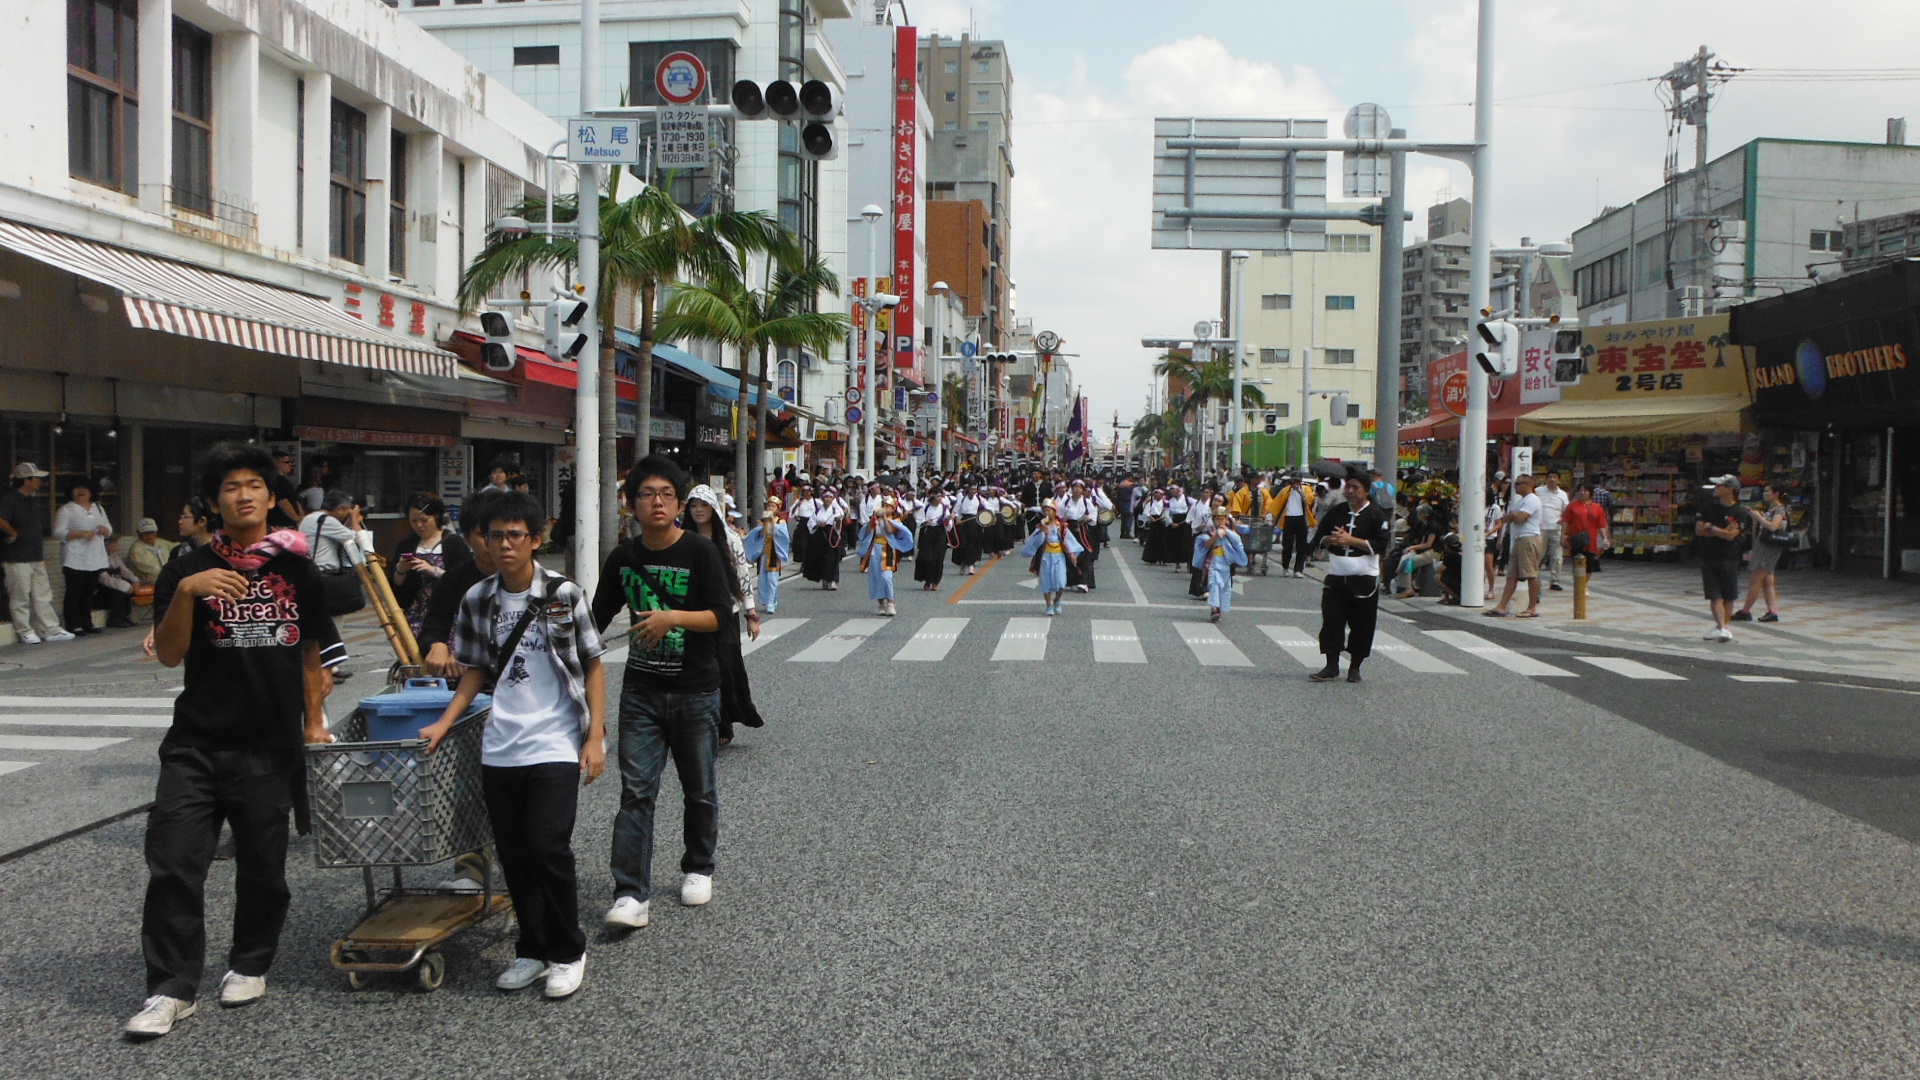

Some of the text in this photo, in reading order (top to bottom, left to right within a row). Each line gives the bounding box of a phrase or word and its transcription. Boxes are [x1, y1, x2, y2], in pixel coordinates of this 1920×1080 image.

[578, 126, 629, 144] 松尾
[584, 146, 621, 157] Matsuo
[897, 120, 914, 232] おきなわ屋
[899, 260, 911, 313] 本社ビル
[1606, 323, 1696, 342] おみやげ屋
[896, 336, 911, 352] P
[1596, 340, 1708, 374] 東宝堂
[1752, 343, 1907, 389] ISLAND BROTHERS
[1615, 372, 1684, 392] 2号店
[220, 599, 300, 622] Break
